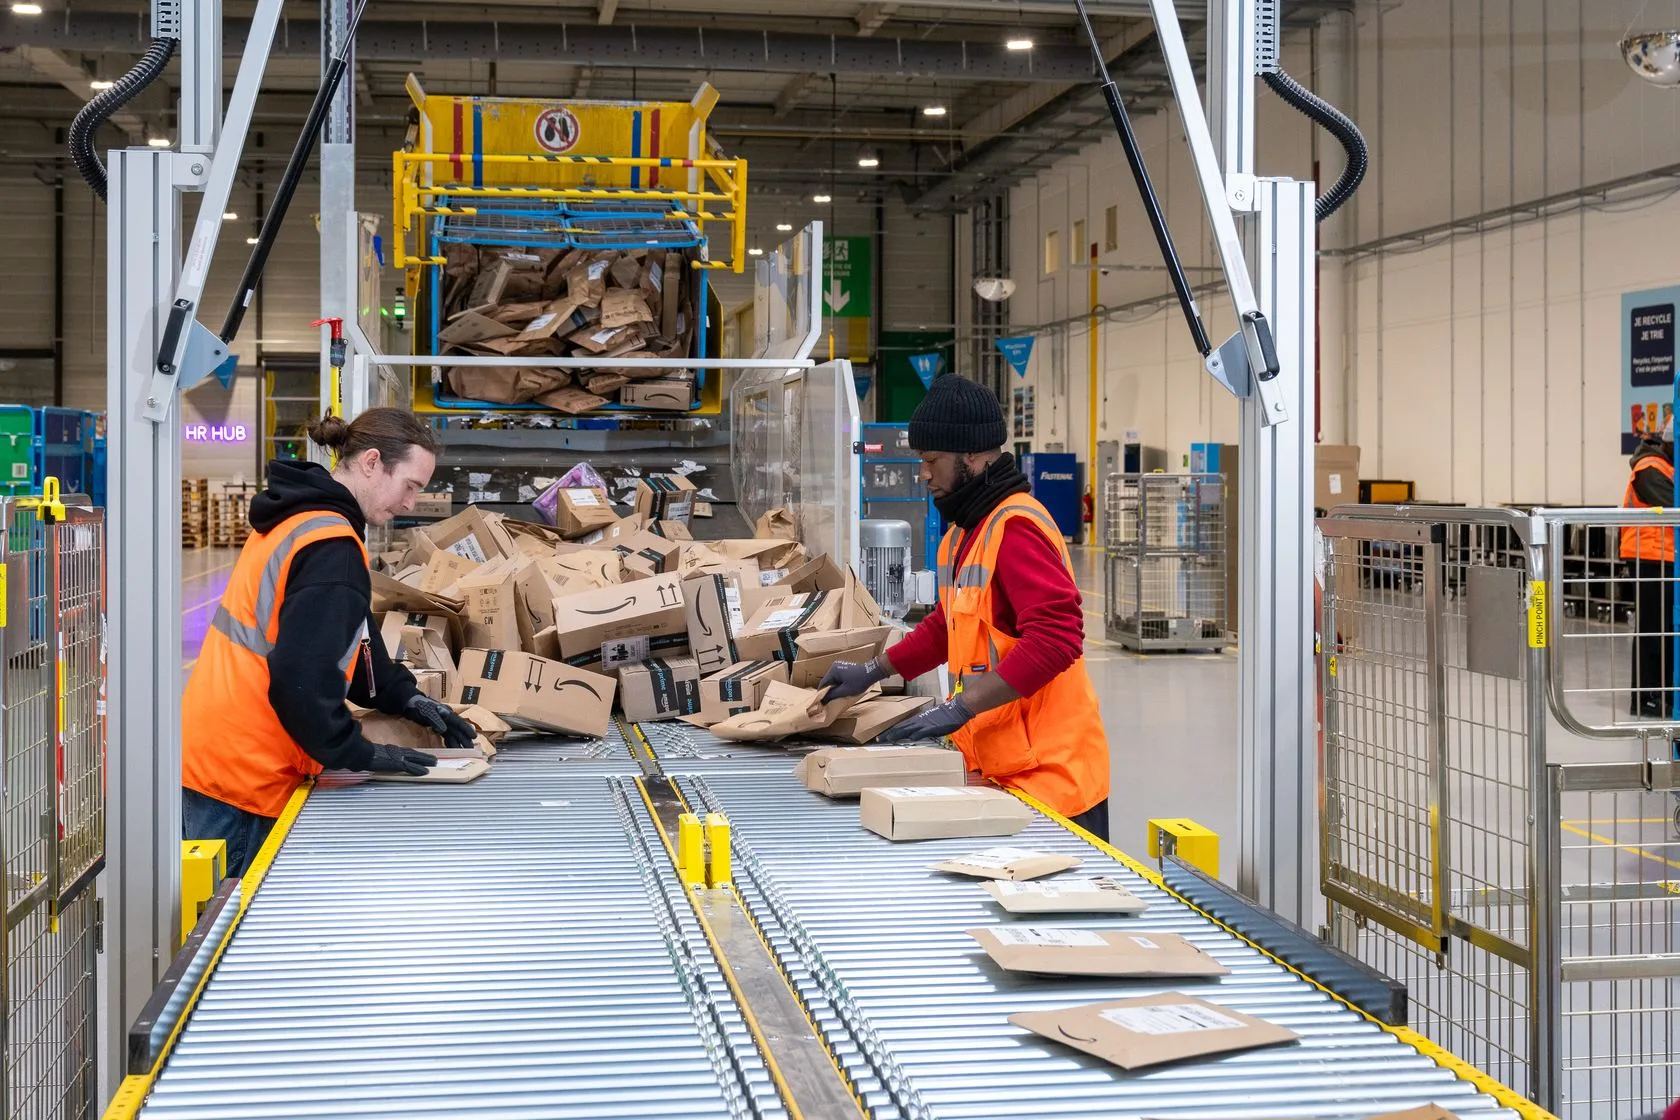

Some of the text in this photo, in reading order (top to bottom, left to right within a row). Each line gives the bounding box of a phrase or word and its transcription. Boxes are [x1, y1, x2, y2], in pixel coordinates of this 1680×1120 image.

[1634, 313, 1672, 327] JE RECYCLE
[1641, 329, 1664, 341] JE TRIE
[185, 425, 247, 441] HR HUB
[1535, 597, 1544, 645] PINCH POINT
[658, 672, 666, 691] prime
